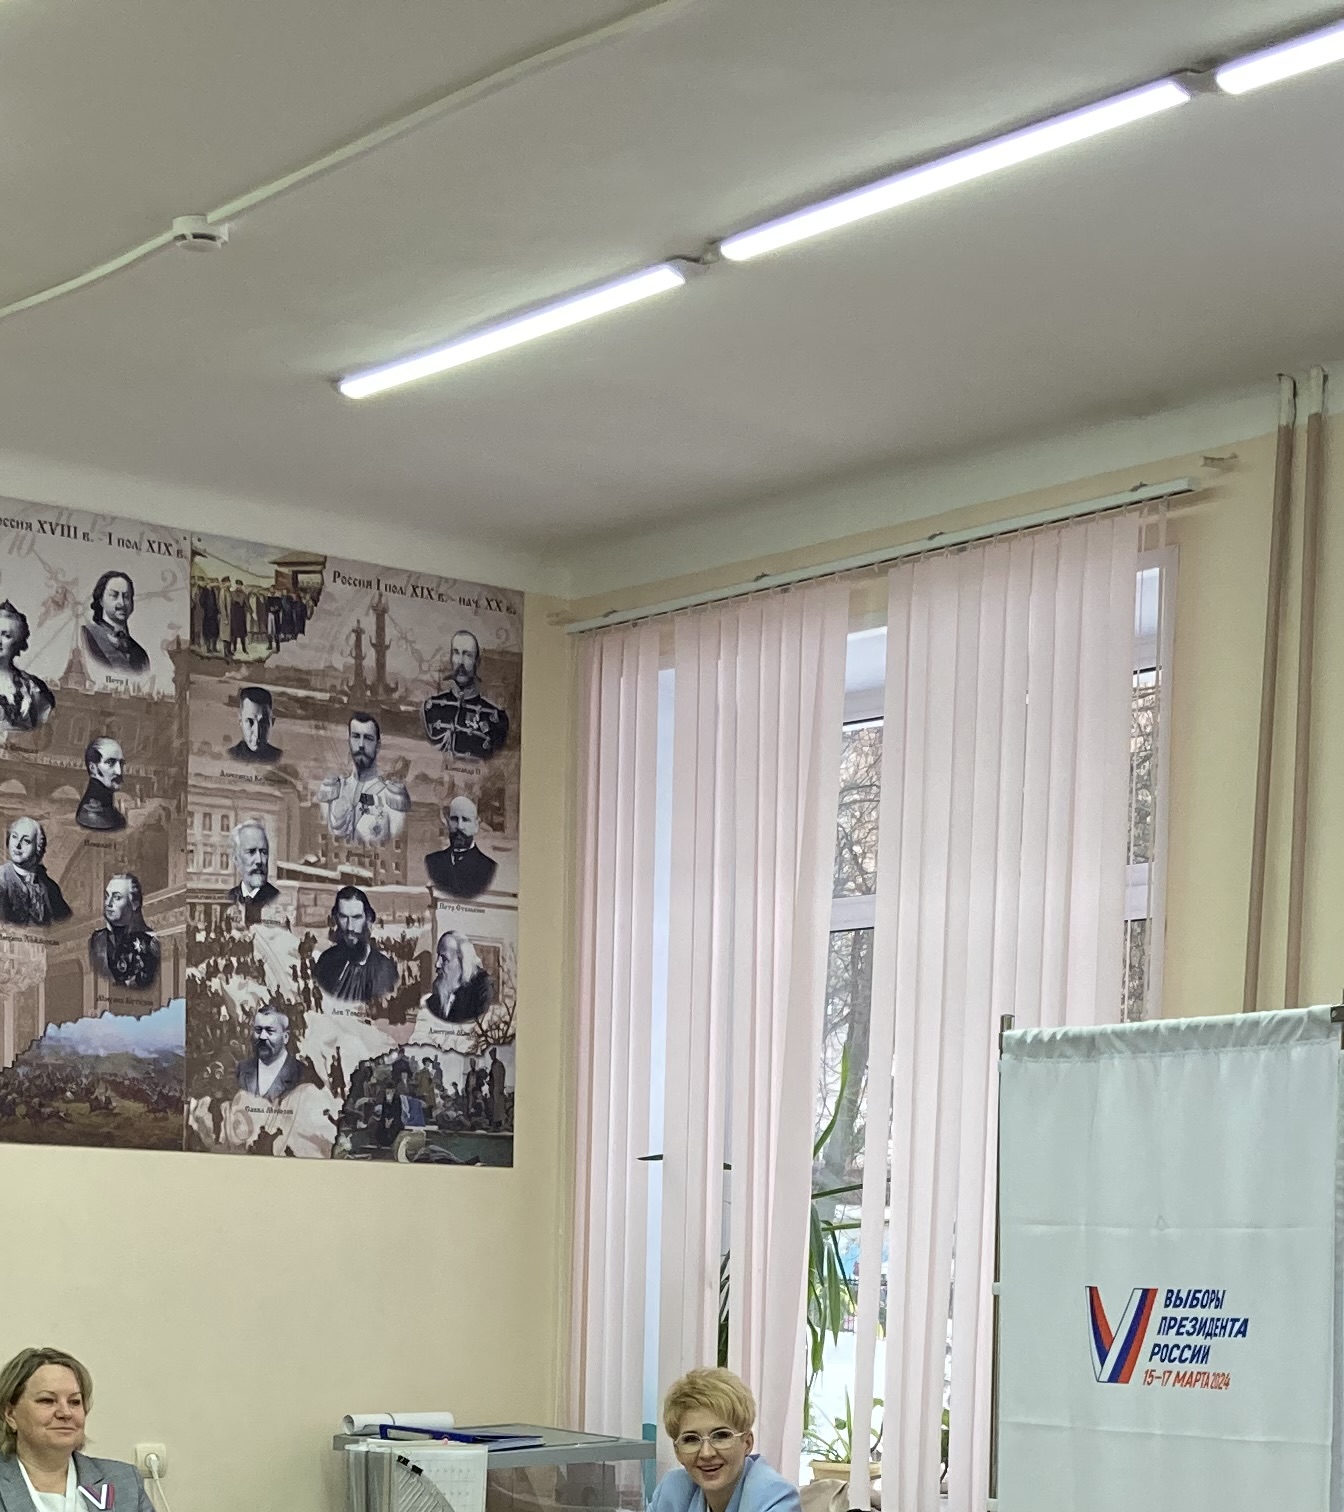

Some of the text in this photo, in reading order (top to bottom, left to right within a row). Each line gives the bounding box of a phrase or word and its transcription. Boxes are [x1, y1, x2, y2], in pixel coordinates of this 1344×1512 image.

[36, 519, 78, 540] XVIII
[82, 531, 94, 543] в.
[107, 531, 112, 546] I
[117, 537, 142, 552] пол.
[146, 538, 173, 557] XIX
[332, 570, 373, 591] Россия
[375, 578, 381, 592] I
[384, 583, 407, 597] пол.
[410, 583, 435, 602] XIX
[437, 591, 449, 603] в.
[458, 596, 482, 610] нач.
[485, 596, 504, 614] XX
[1163, 1288, 1227, 1309] ВЫБОРЫ
[1156, 1316, 1249, 1341] ПРЕЗИДЕНТА
[1148, 1343, 1211, 1365] РОССИИ
[1172, 1370, 1210, 1390] МАРТА
[1210, 1372, 1231, 1390] 2024
